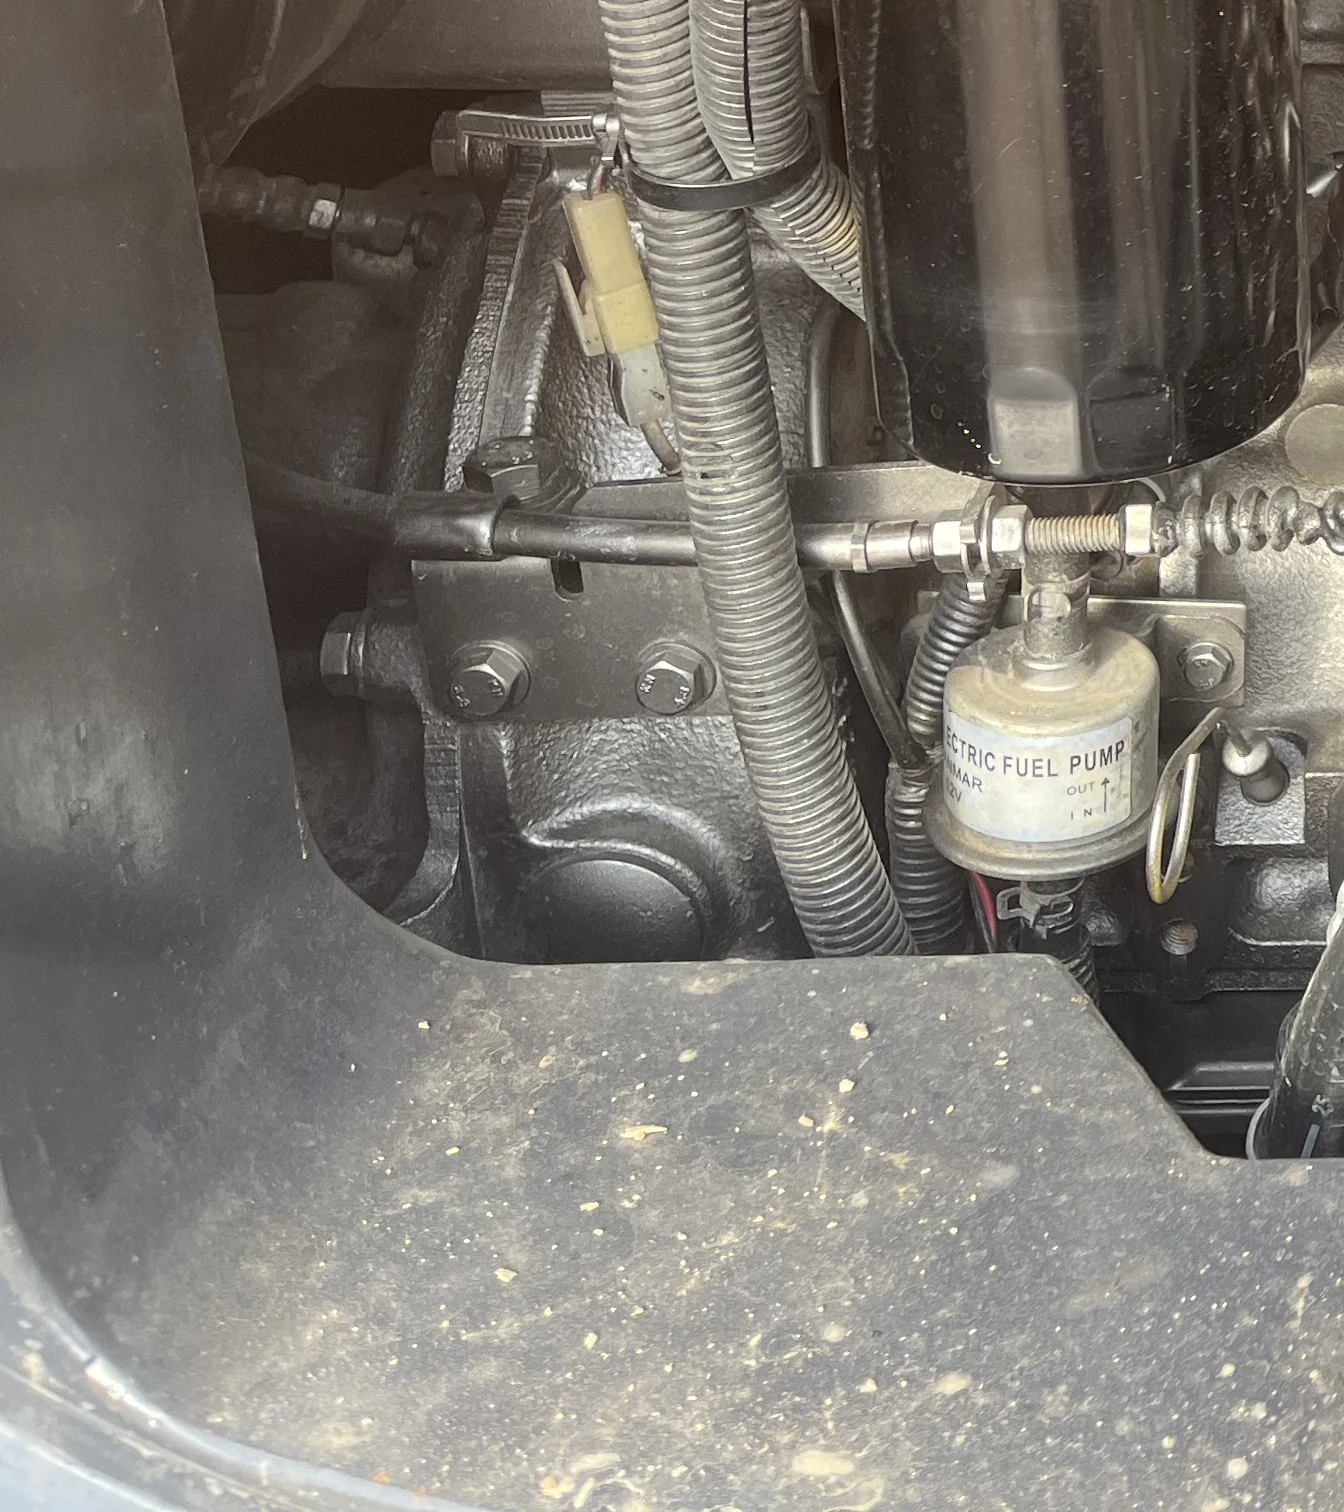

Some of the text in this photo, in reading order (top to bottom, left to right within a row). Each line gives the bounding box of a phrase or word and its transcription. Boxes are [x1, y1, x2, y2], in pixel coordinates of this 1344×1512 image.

[946, 725, 1125, 778] ECTRIC FUEL PUMP
[1066, 781, 1096, 796] OUT
